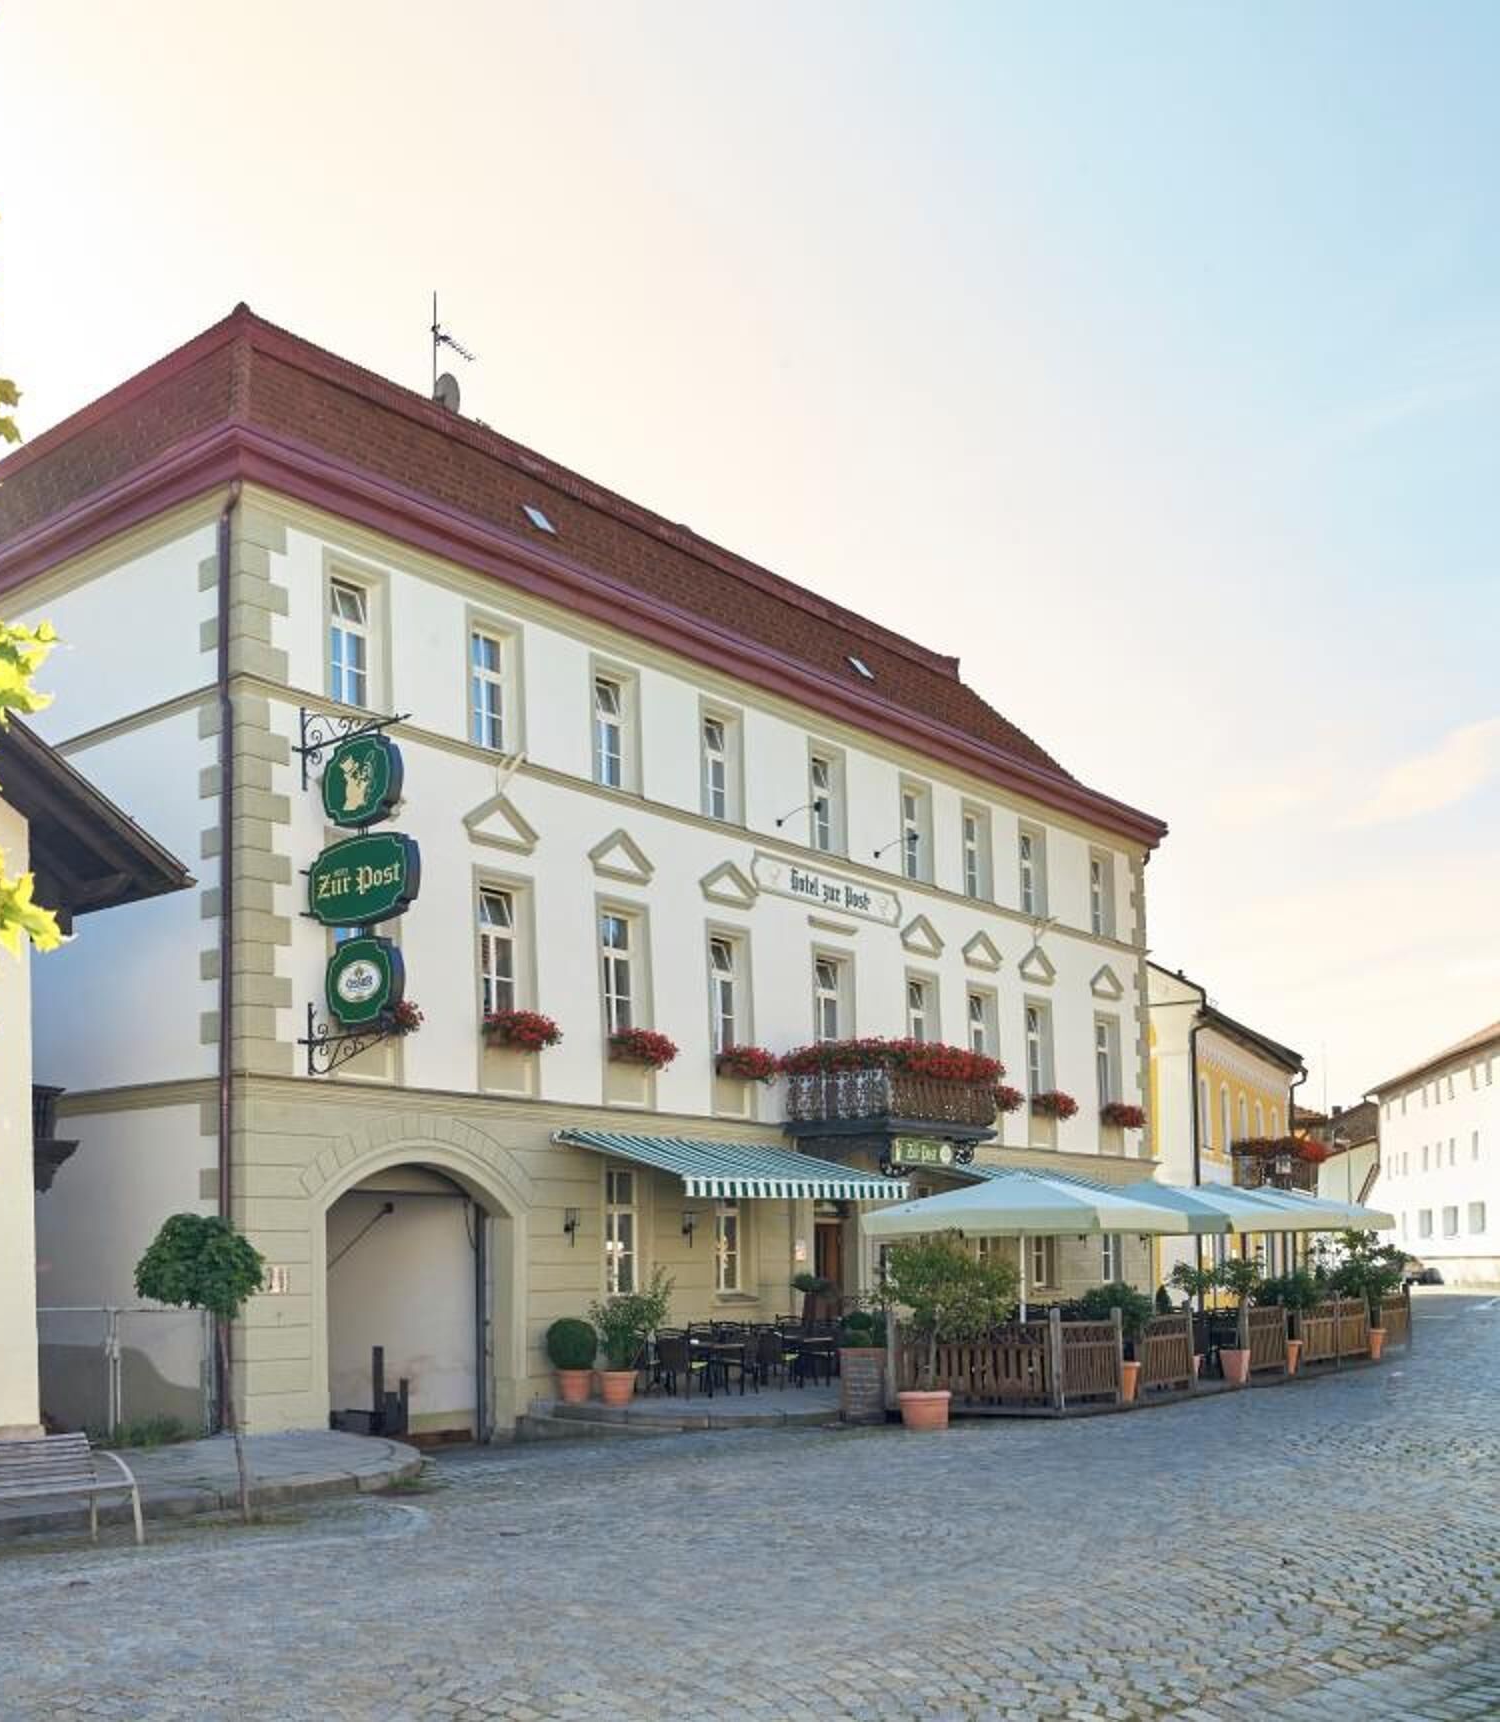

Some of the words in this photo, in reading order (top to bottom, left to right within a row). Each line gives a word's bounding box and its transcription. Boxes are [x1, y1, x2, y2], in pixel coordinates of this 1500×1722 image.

[317, 873, 351, 899] Zur
[356, 861, 401, 895] Post
[790, 867, 819, 897] Hotel
[822, 883, 841, 904] zur
[845, 885, 871, 911] Post
